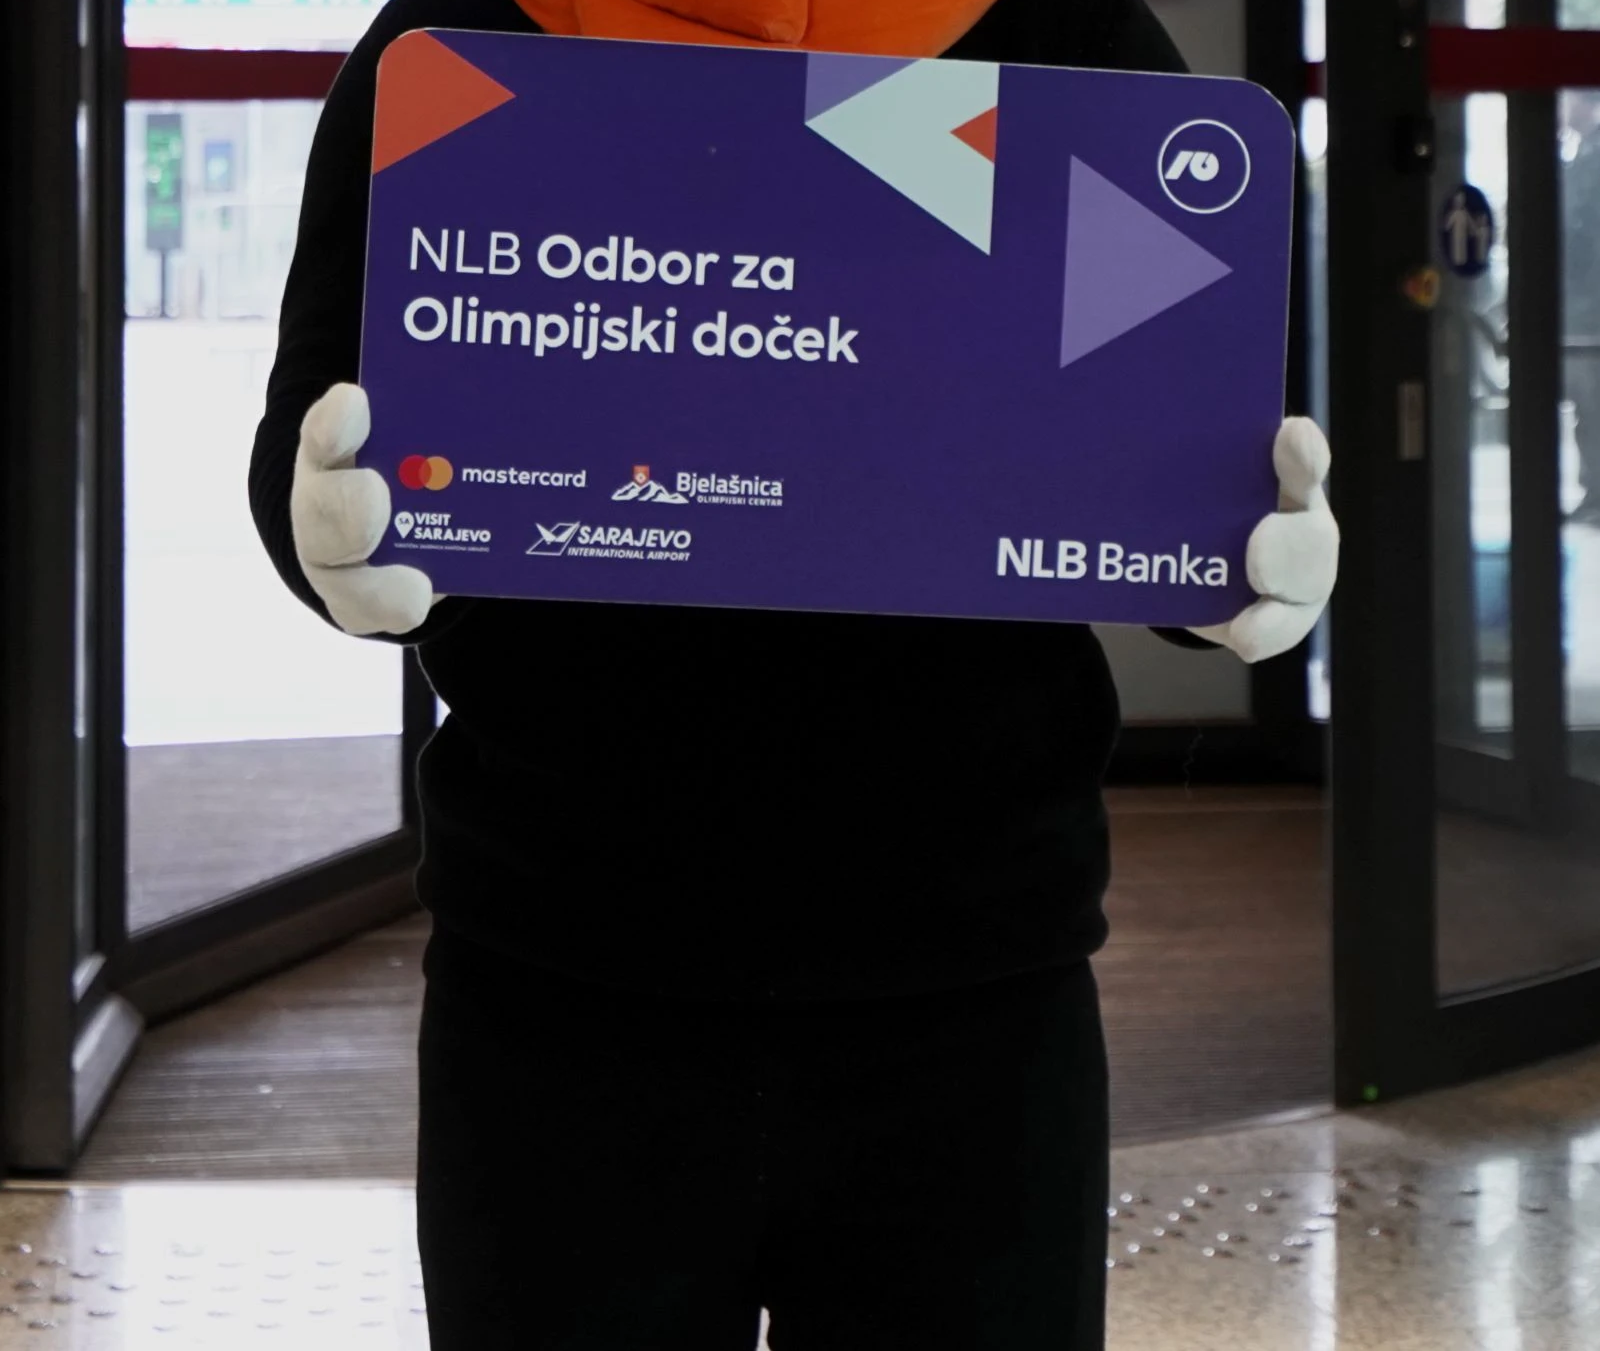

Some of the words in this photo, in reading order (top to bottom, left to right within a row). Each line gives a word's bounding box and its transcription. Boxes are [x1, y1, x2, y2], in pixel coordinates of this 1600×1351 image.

[409, 227, 521, 276] NLB
[536, 234, 719, 286] Odbor
[731, 254, 795, 291] za
[403, 296, 678, 360] Olimpijski
[692, 311, 860, 364] doček
[462, 467, 587, 488] mastercard
[676, 471, 784, 498] Bjelašnica
[696, 494, 747, 506] OLIMPIJSKI
[748, 496, 784, 507] CENTAR
[414, 512, 452, 527] VISIT
[414, 526, 492, 543] SARAJEVO
[577, 525, 692, 549] SARAJEVO
[567, 546, 645, 560] INTERNATIONAL
[646, 550, 691, 562] AIRPORT
[996, 537, 1088, 580] NLB
[1097, 541, 1229, 587] Banka
